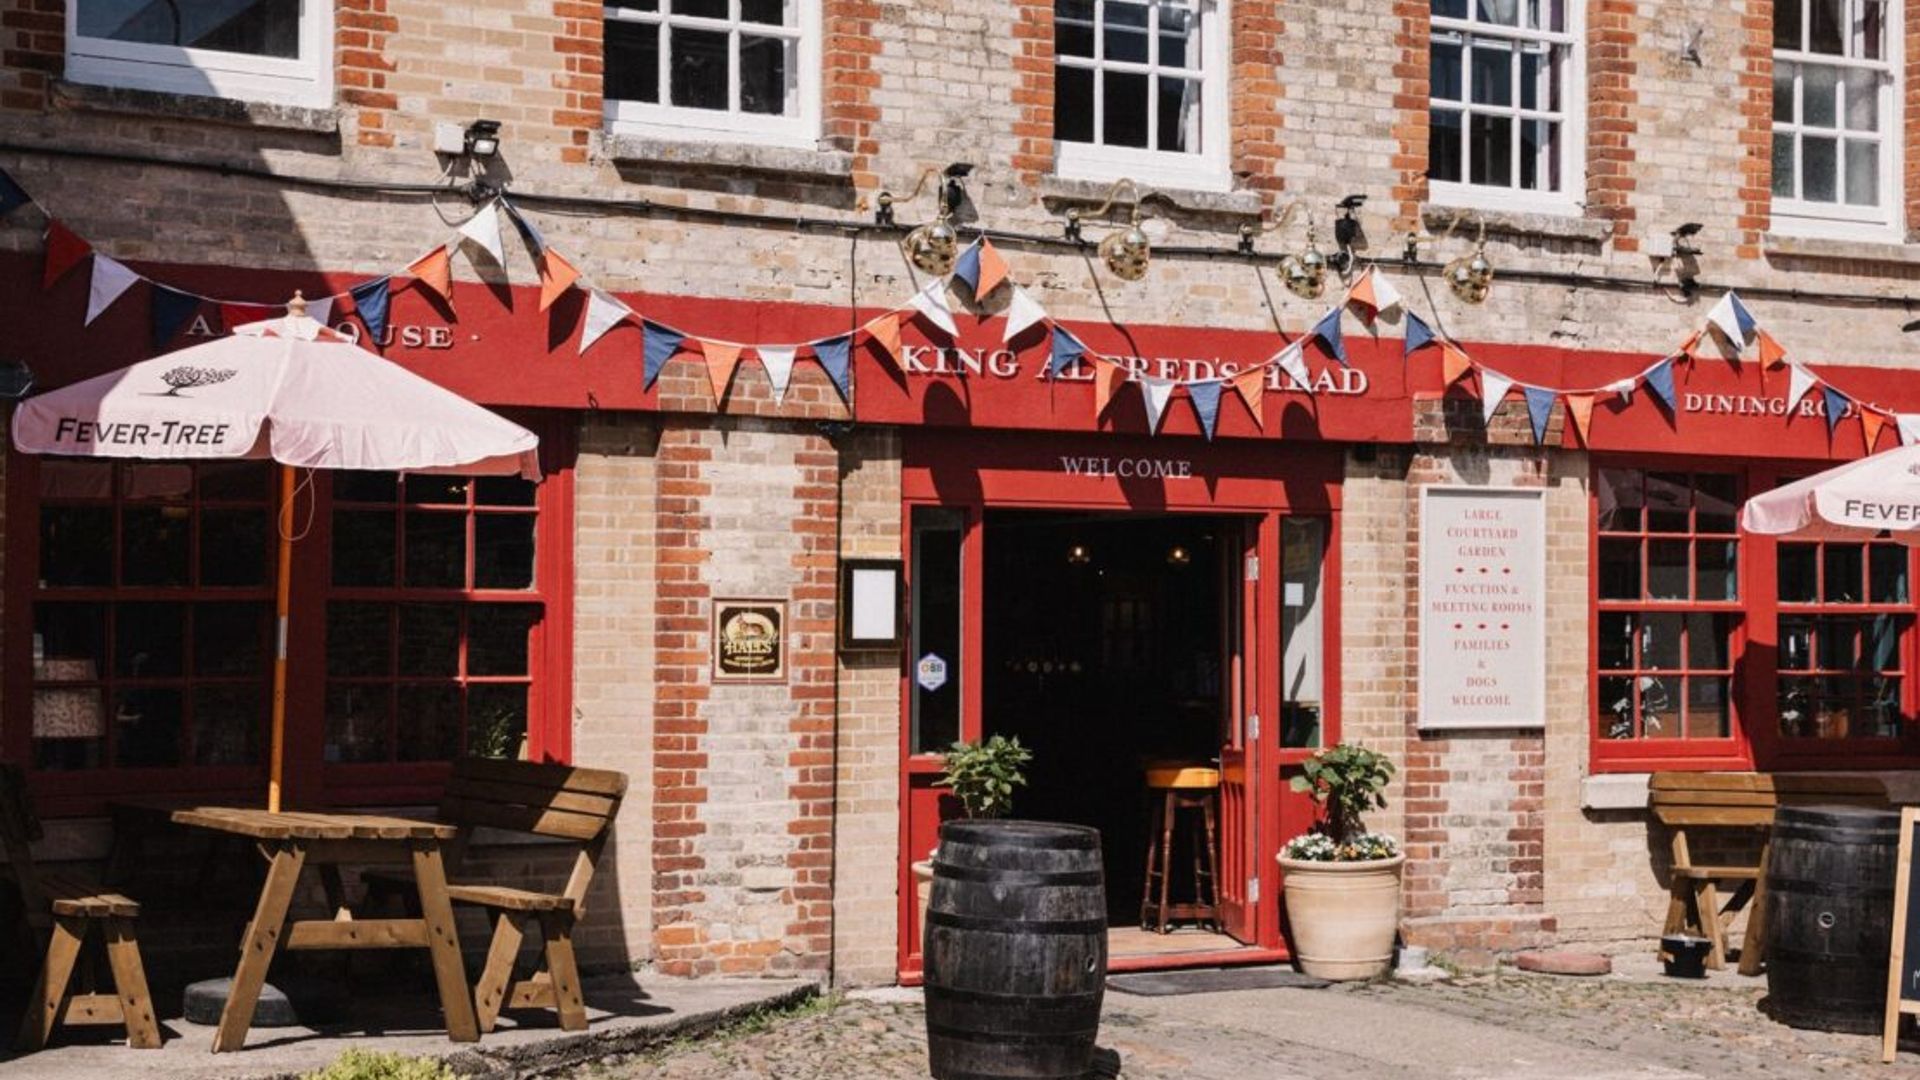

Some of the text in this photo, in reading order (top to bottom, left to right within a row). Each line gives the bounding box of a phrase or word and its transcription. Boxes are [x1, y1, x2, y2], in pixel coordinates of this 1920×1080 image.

[901, 345, 1020, 378] KING
[1684, 393, 1786, 416] DINING
[55, 417, 230, 445] FEVER-TREE
[1060, 456, 1193, 479] WELCOME
[1464, 508, 1503, 520] LARGE
[1446, 527, 1519, 539] COURTYARD
[1458, 545, 1507, 557] GARDEN
[1444, 583, 1508, 595] FUNCTION
[1431, 601, 1533, 614] MEETING ROOMS
[1453, 639, 1511, 651] FAMILIES
[1465, 676, 1498, 688] DOGS
[1451, 694, 1512, 706] WELCOME
